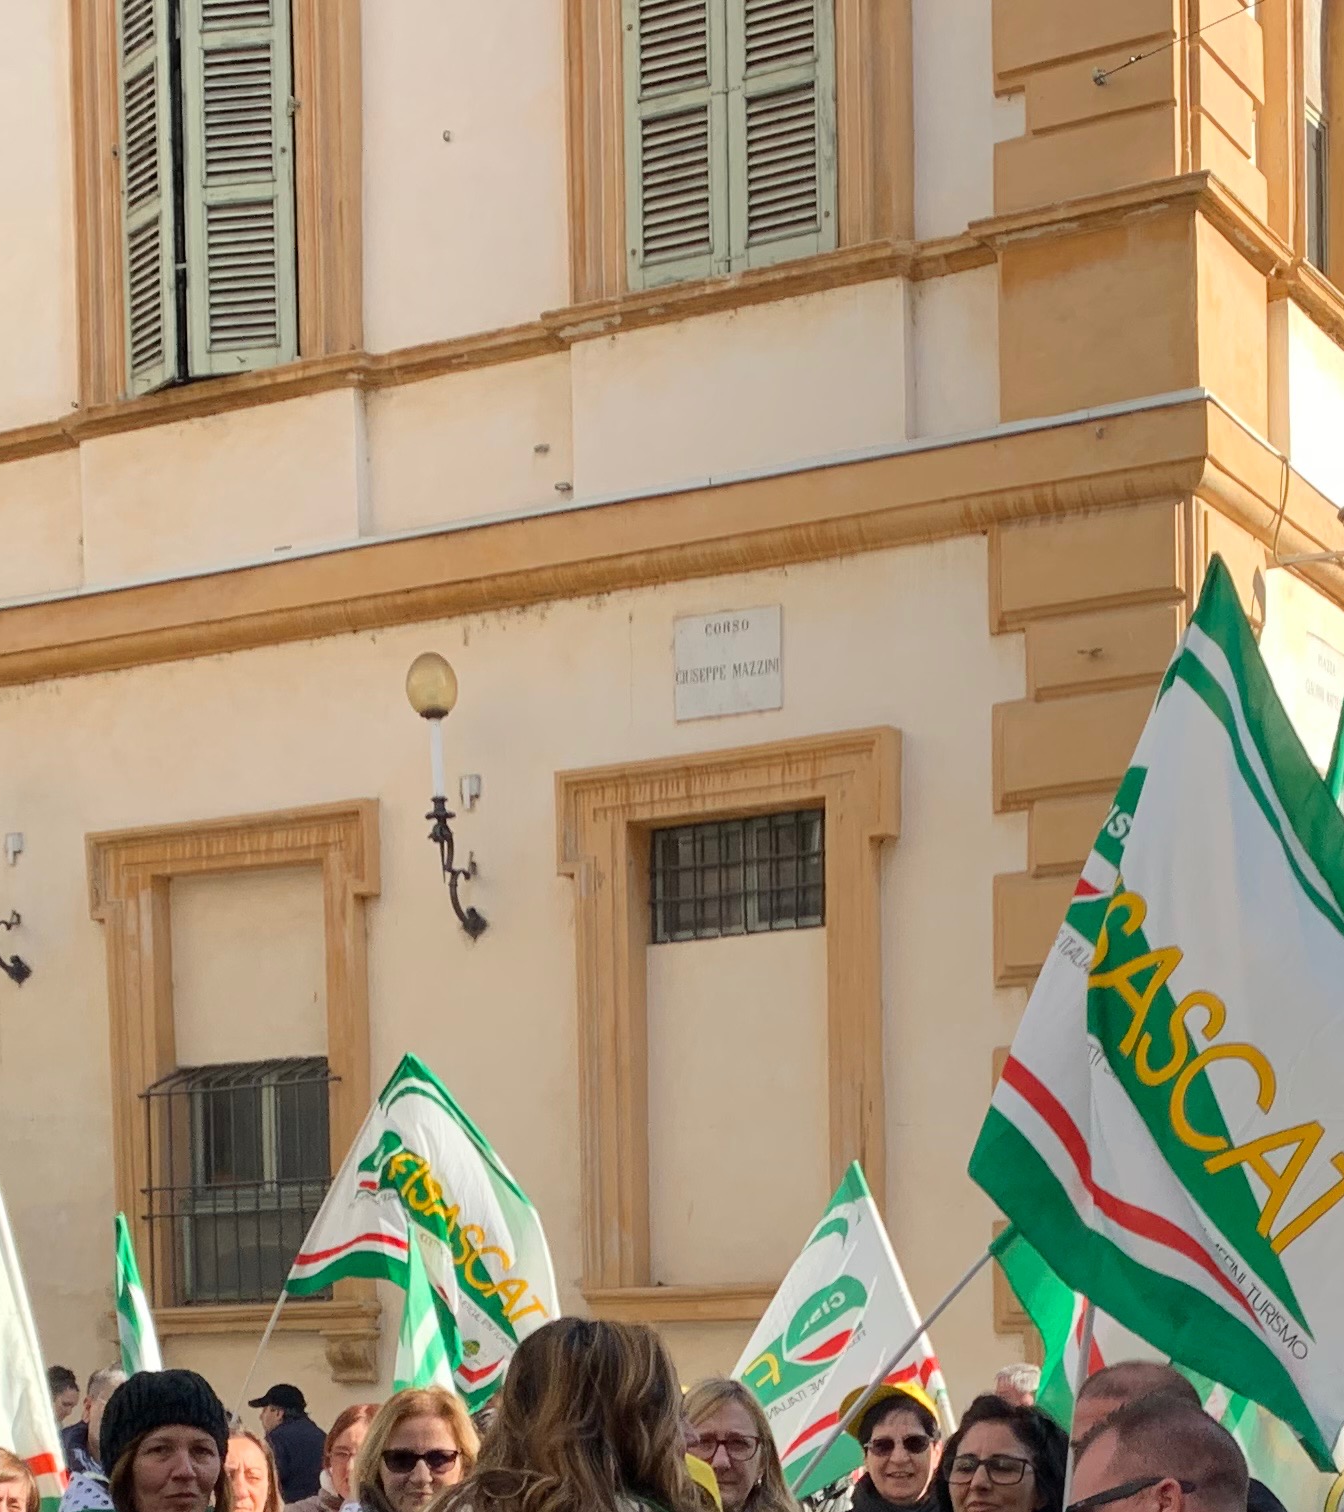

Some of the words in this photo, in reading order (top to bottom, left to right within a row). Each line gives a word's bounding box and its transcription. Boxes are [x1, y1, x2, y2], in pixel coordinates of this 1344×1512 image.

[704, 618, 750, 636] CORSO
[675, 664, 727, 686] GIUSEPPE
[732, 657, 780, 680] MAZZINI
[1245, 1282, 1309, 1360] TURISMO
